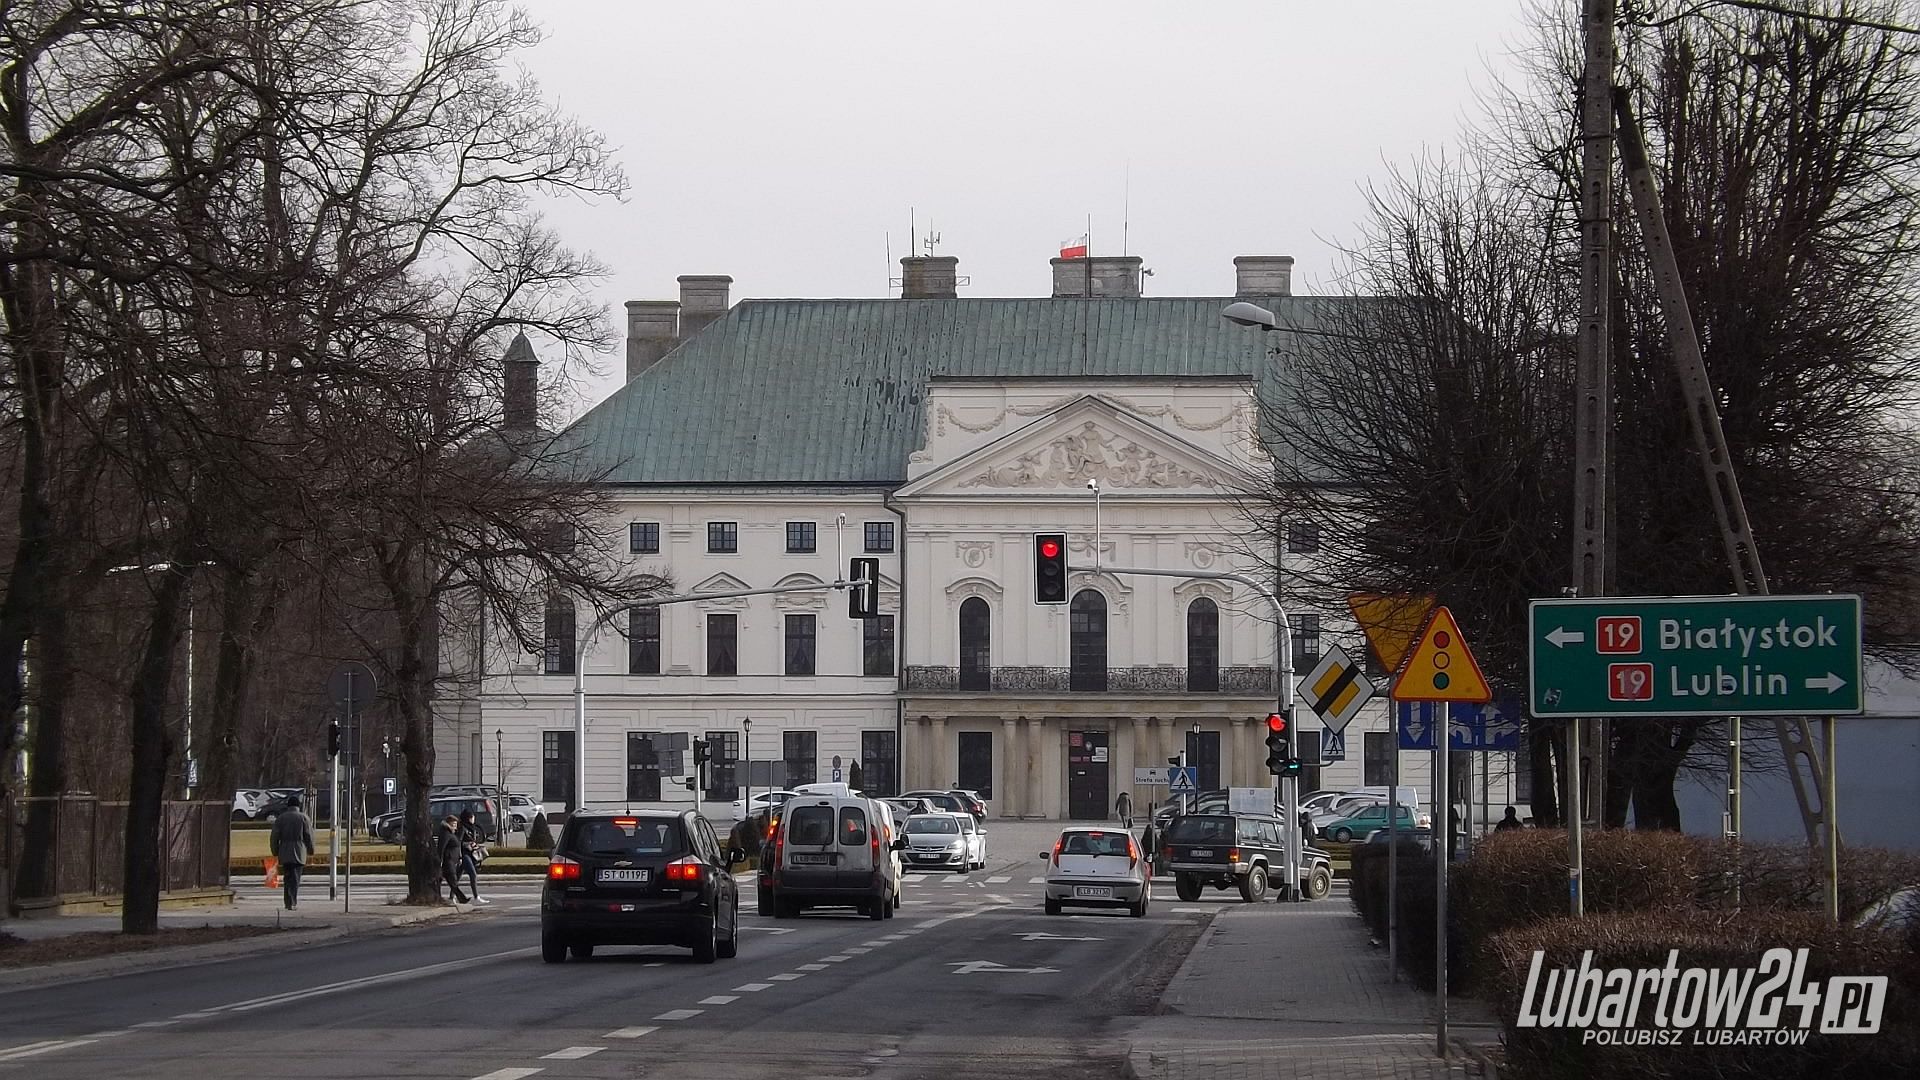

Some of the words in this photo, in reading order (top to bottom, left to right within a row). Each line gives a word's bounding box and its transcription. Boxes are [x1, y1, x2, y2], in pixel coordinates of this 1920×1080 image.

[1604, 623, 1634, 648] 19
[1659, 616, 1837, 658] Białystok
[1616, 669, 1646, 694] 19
[1671, 664, 1788, 696] Lublin
[604, 870, 617, 879] ST
